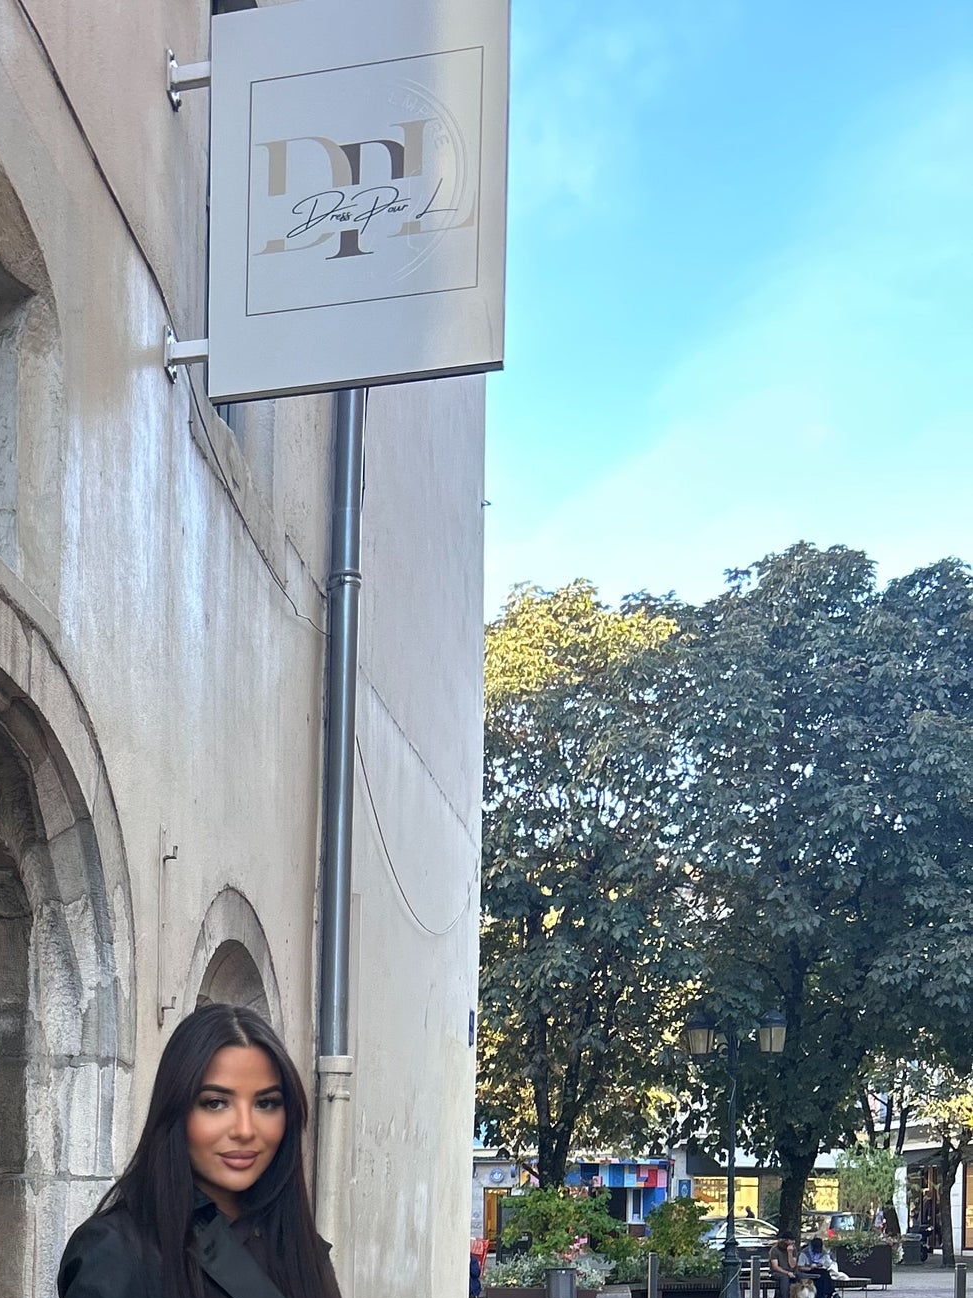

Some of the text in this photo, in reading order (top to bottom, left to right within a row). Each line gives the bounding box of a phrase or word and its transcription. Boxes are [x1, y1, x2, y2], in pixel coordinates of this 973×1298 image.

[286, 178, 459, 239] Dress Pour L
